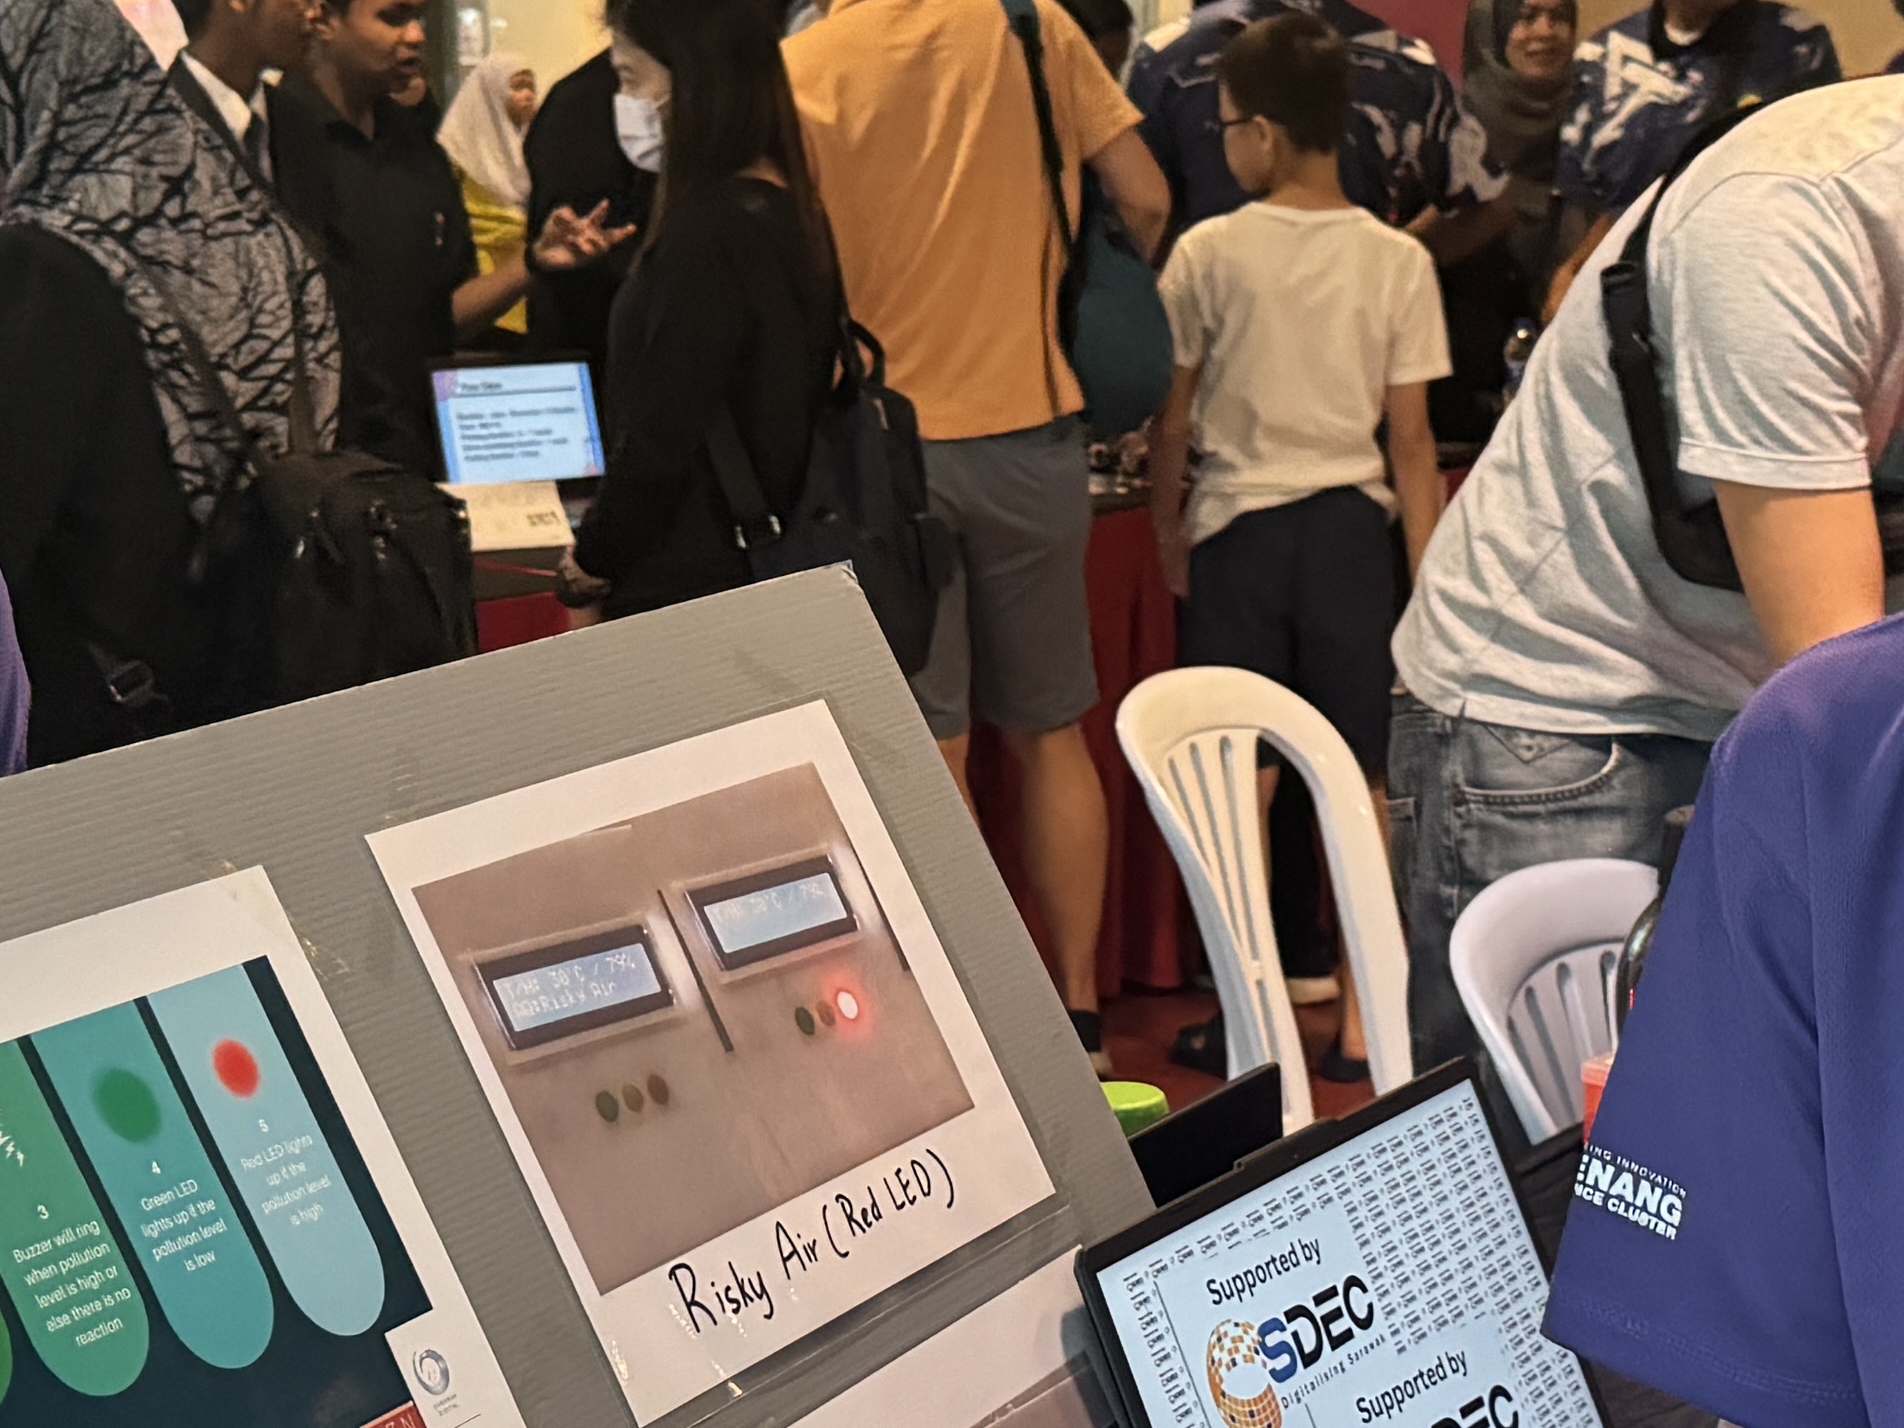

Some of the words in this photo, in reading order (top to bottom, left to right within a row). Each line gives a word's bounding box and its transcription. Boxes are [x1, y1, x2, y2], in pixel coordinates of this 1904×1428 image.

[258, 1118, 269, 1132] 5
[151, 1160, 162, 1174] 4
[240, 1154, 263, 1170] Red
[262, 1144, 285, 1163] LED
[265, 1172, 281, 1186] up
[1616, 1155, 1687, 1199] INNOVATION
[37, 1204, 49, 1220] 3
[140, 1190, 176, 1211] Green
[173, 1179, 198, 1198] LED
[261, 1186, 306, 1215] pollution
[297, 1203, 324, 1221] high
[1577, 1154, 1683, 1228] NANG
[140, 1216, 174, 1238] lights
[172, 1210, 190, 1226] up
[196, 1198, 217, 1215] the
[152, 1230, 202, 1262] pollution
[198, 1217, 228, 1239] level
[1607, 1197, 1677, 1241] CLUSTER
[12, 1238, 53, 1264] Buzzer
[53, 1227, 77, 1247] will
[76, 1220, 101, 1237] ring
[183, 1258, 196, 1271] is
[193, 1250, 216, 1268] low
[668, 1261, 775, 1334] Risky
[775, 1221, 817, 1280] Air
[822, 1185, 883, 1259] (Red
[883, 1148, 955, 1211] LED)
[24, 1263, 59, 1287] when
[59, 1242, 111, 1275] pollution
[1206, 1241, 1301, 1306] Supported
[1298, 1237, 1321, 1266] by
[34, 1285, 66, 1309] level
[65, 1282, 79, 1296] is
[76, 1270, 106, 1290] high
[105, 1265, 119, 1280] or
[47, 1312, 72, 1332] else
[71, 1299, 103, 1321] there
[103, 1294, 115, 1307] is
[114, 1287, 132, 1304] no
[75, 1316, 124, 1346] reaction
[1257, 1274, 1375, 1384] SDEC
[1280, 1360, 1346, 1410] Digitalising
[1347, 1333, 1386, 1366] Sarawak
[1356, 1355, 1448, 1424] Supported
[1445, 1349, 1468, 1378] by
